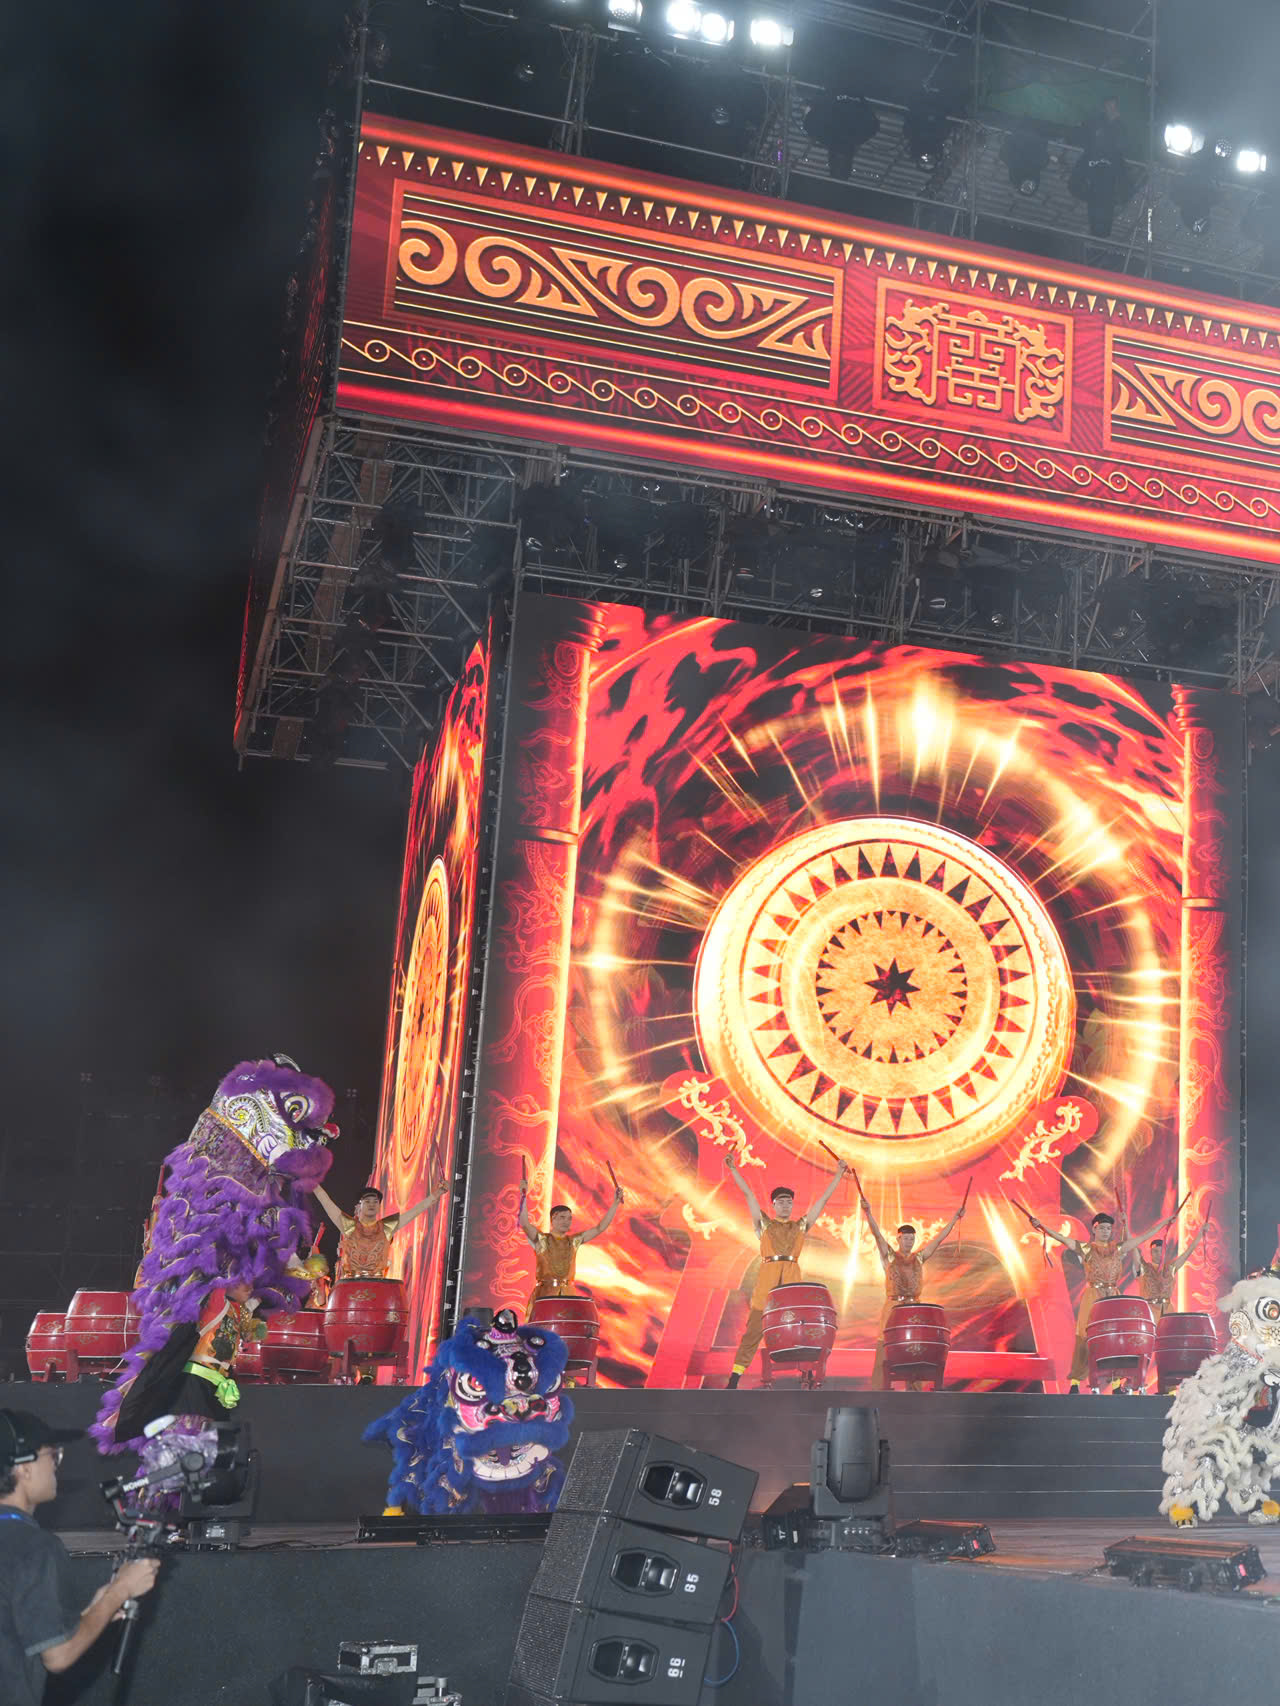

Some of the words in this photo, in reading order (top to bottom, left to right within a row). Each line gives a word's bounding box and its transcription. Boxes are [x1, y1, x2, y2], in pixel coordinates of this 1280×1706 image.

[708, 1488, 722, 1506] 58
[684, 1573, 699, 1593] 65
[667, 1657, 685, 1678] 66
